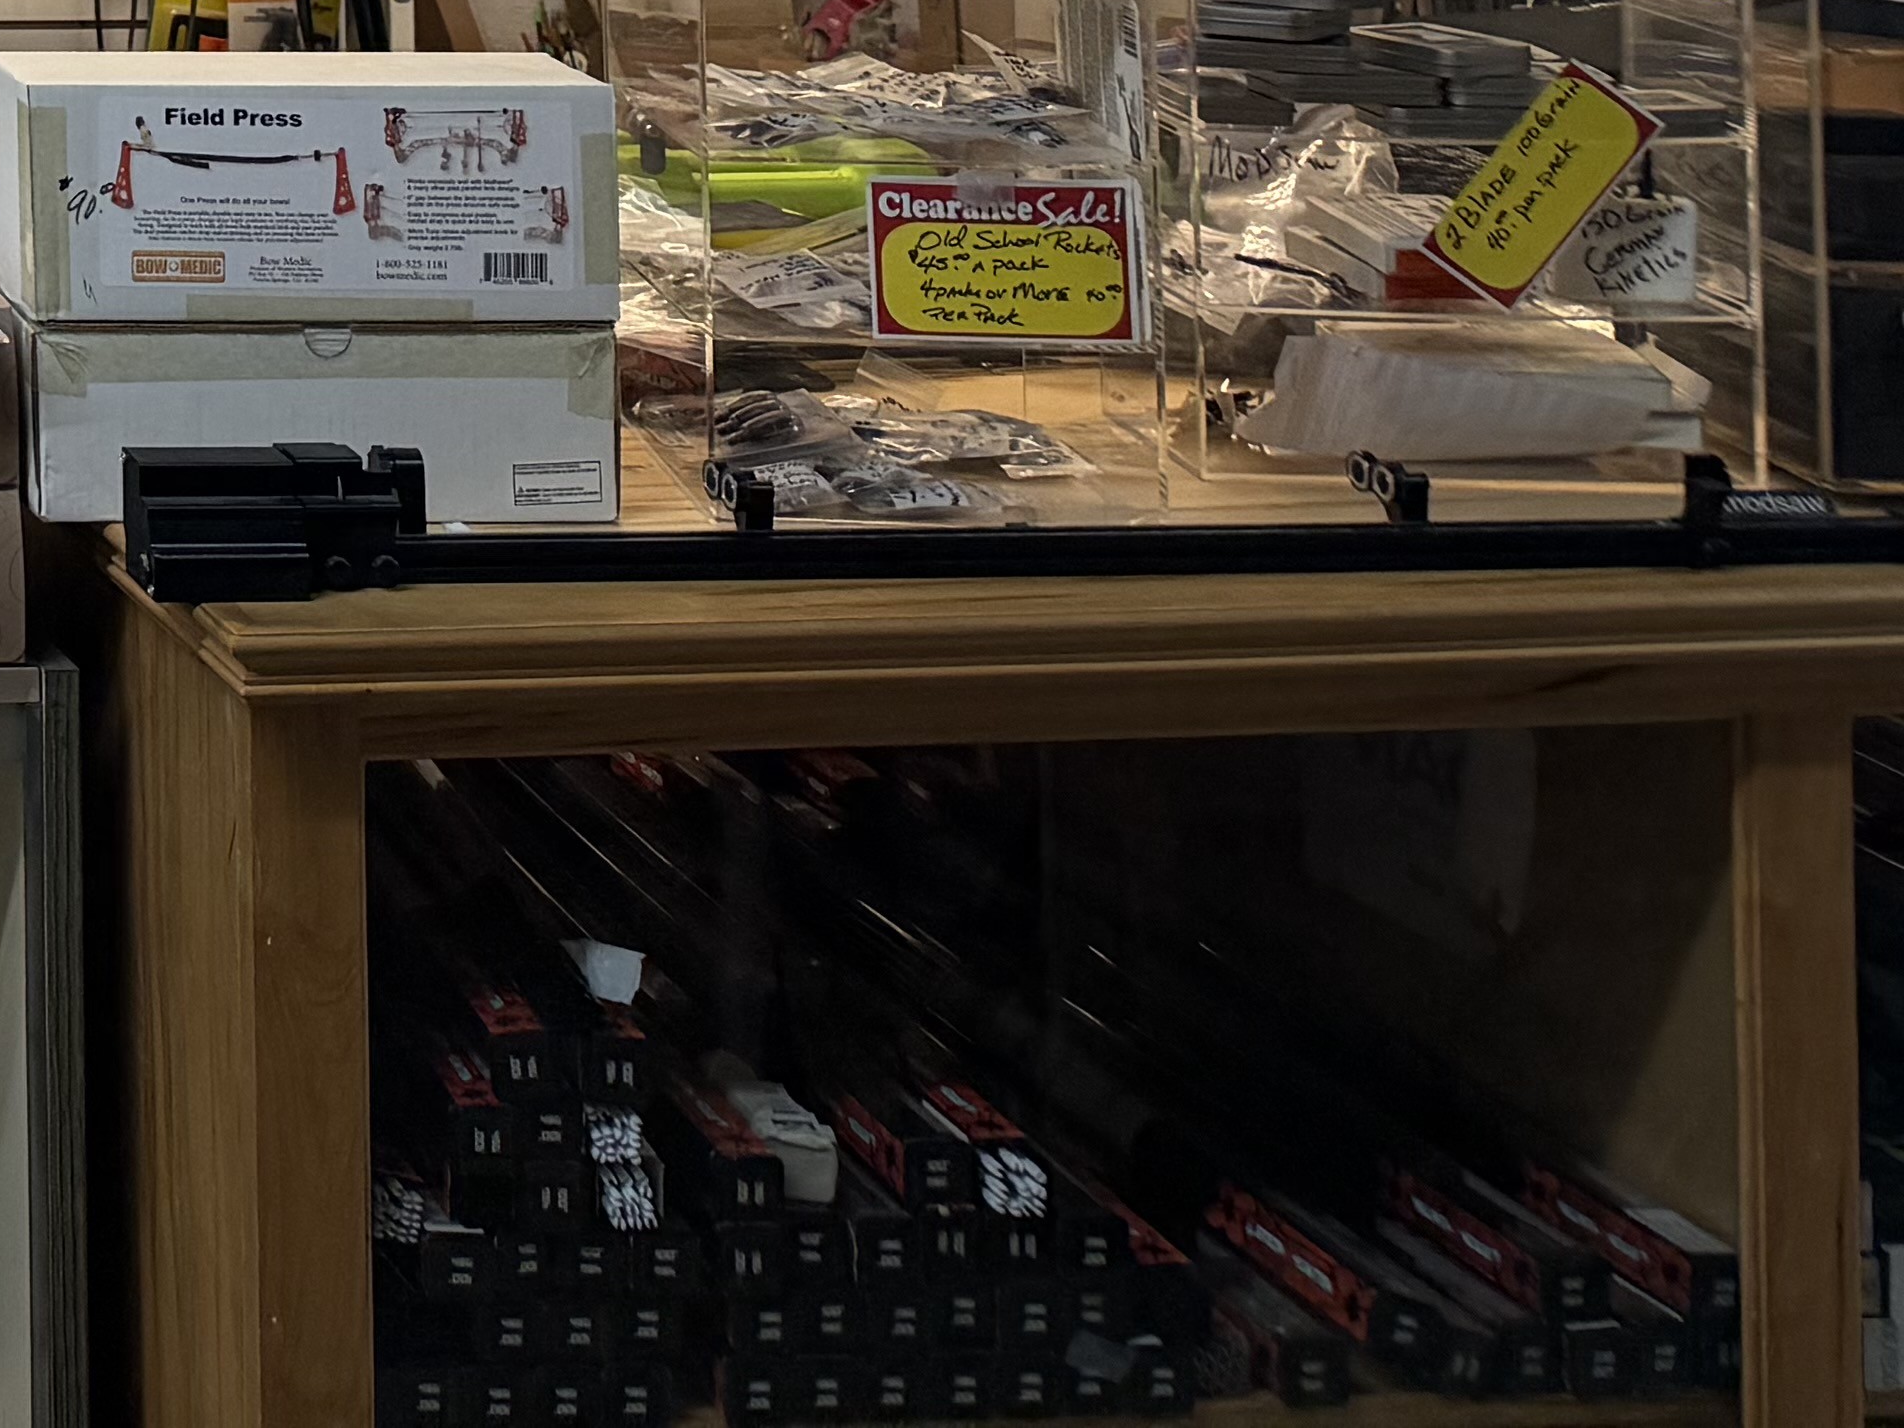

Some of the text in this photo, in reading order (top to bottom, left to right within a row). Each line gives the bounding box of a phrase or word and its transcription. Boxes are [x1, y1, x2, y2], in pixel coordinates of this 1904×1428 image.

[164, 107, 303, 128] Field Press
[878, 188, 1123, 228] Clearance Sale!
[914, 225, 966, 255] Old
[135, 257, 222, 275] BOW MEDIC
